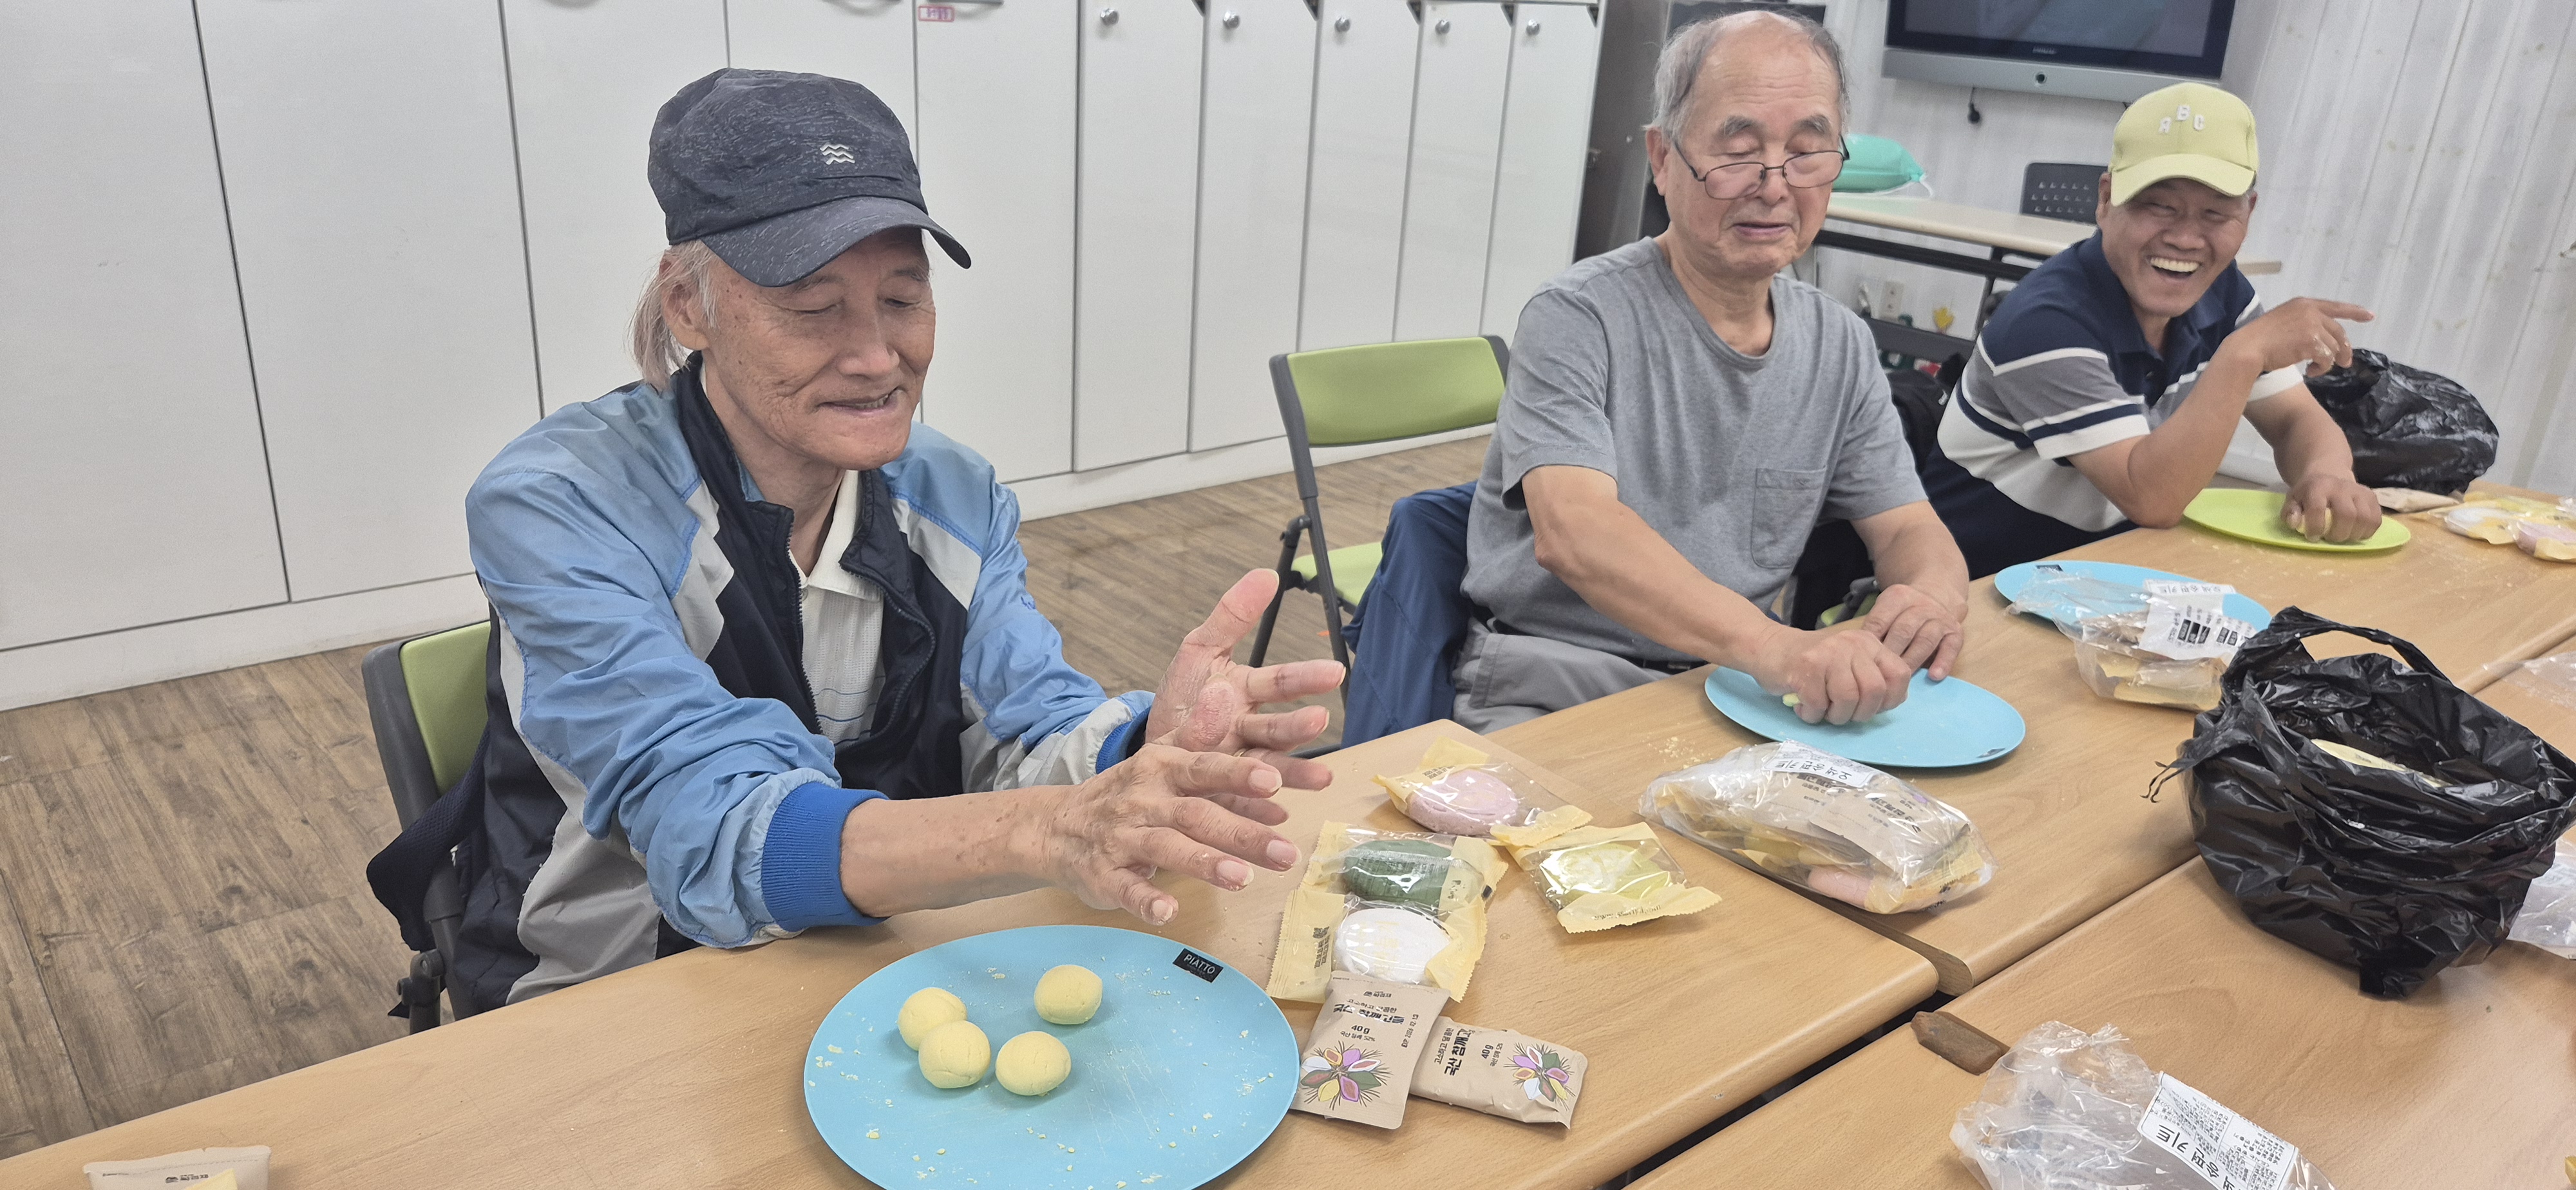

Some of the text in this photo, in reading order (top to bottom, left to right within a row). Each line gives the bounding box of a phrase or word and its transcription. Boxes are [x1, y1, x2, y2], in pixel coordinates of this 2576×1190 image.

[2159, 105, 2206, 134] ABC
[1775, 759, 1852, 780] 오색 송편 키트
[1183, 954, 1215, 974] PIATTO
[1481, 1044, 1493, 1059] 40g
[1444, 1058, 1462, 1076] 국산
[2155, 1124, 2189, 1153] 키트
[2191, 1148, 2219, 1178] 송편
